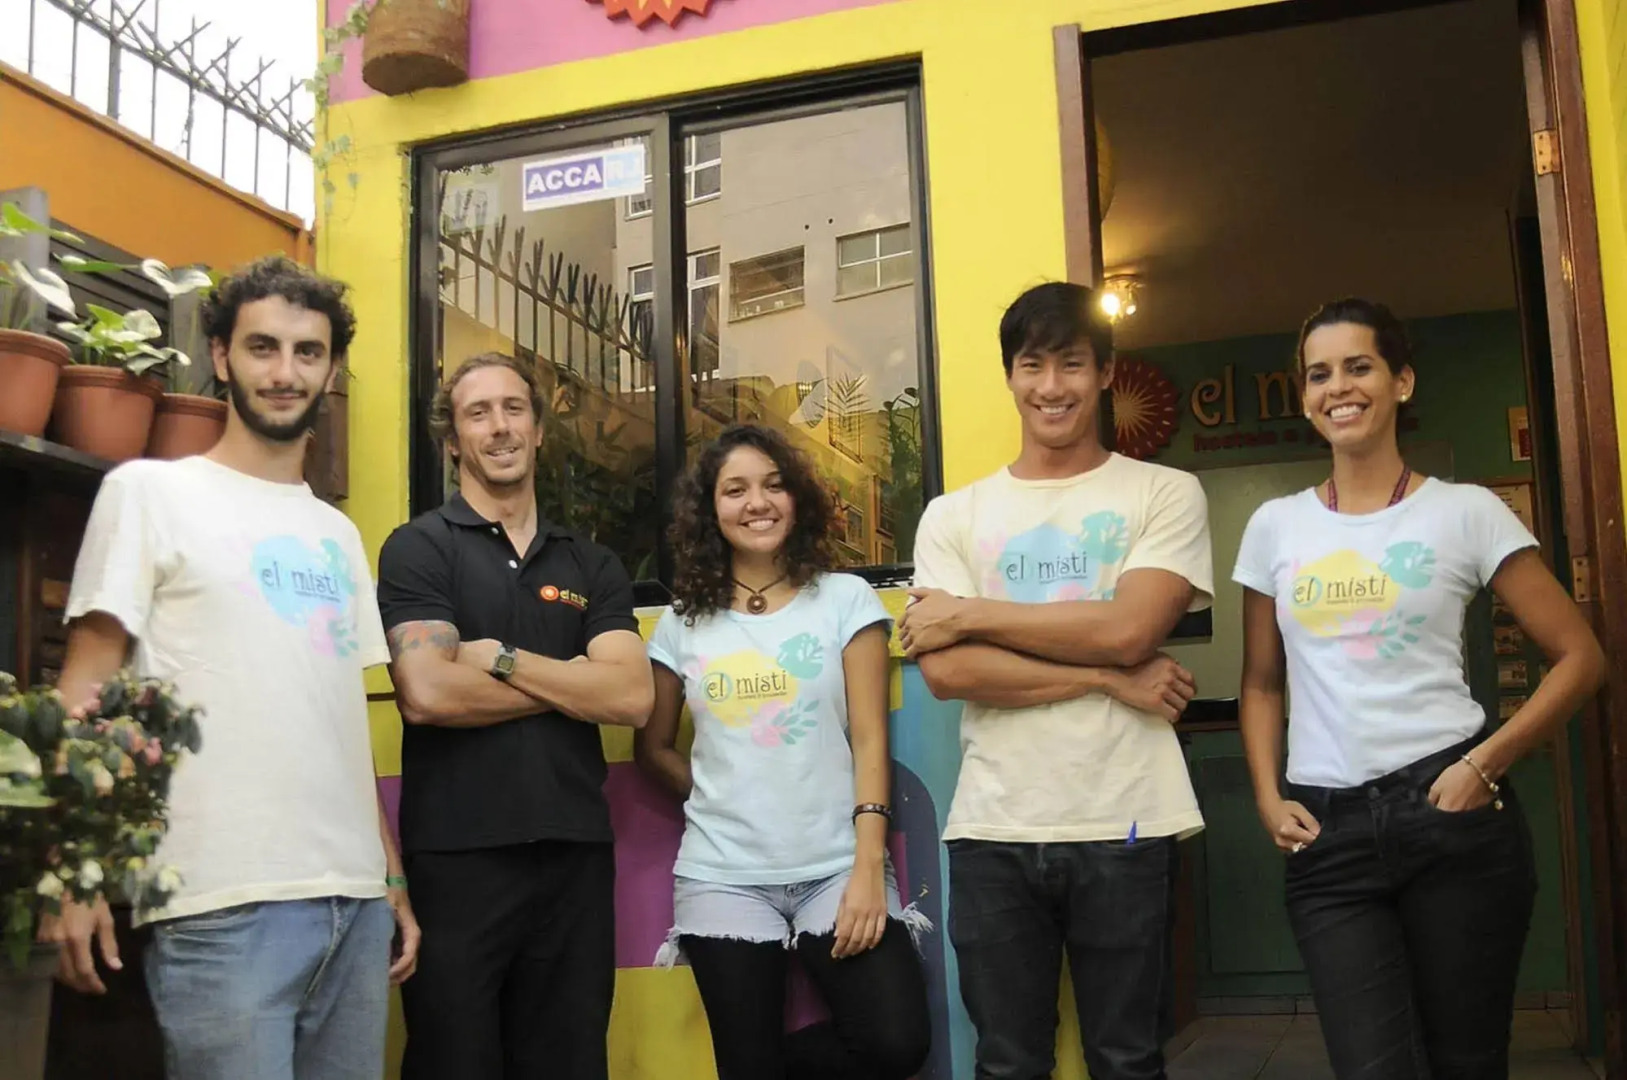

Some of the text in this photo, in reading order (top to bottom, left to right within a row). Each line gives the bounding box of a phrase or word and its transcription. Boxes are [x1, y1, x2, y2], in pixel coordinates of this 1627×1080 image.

[527, 166, 603, 195] ACCA
[1190, 362, 1236, 426] el
[261, 560, 281, 588] el
[291, 567, 341, 597] misti
[1006, 551, 1088, 582] el misti
[1293, 574, 1388, 604] el misti
[706, 669, 787, 699] el misti
